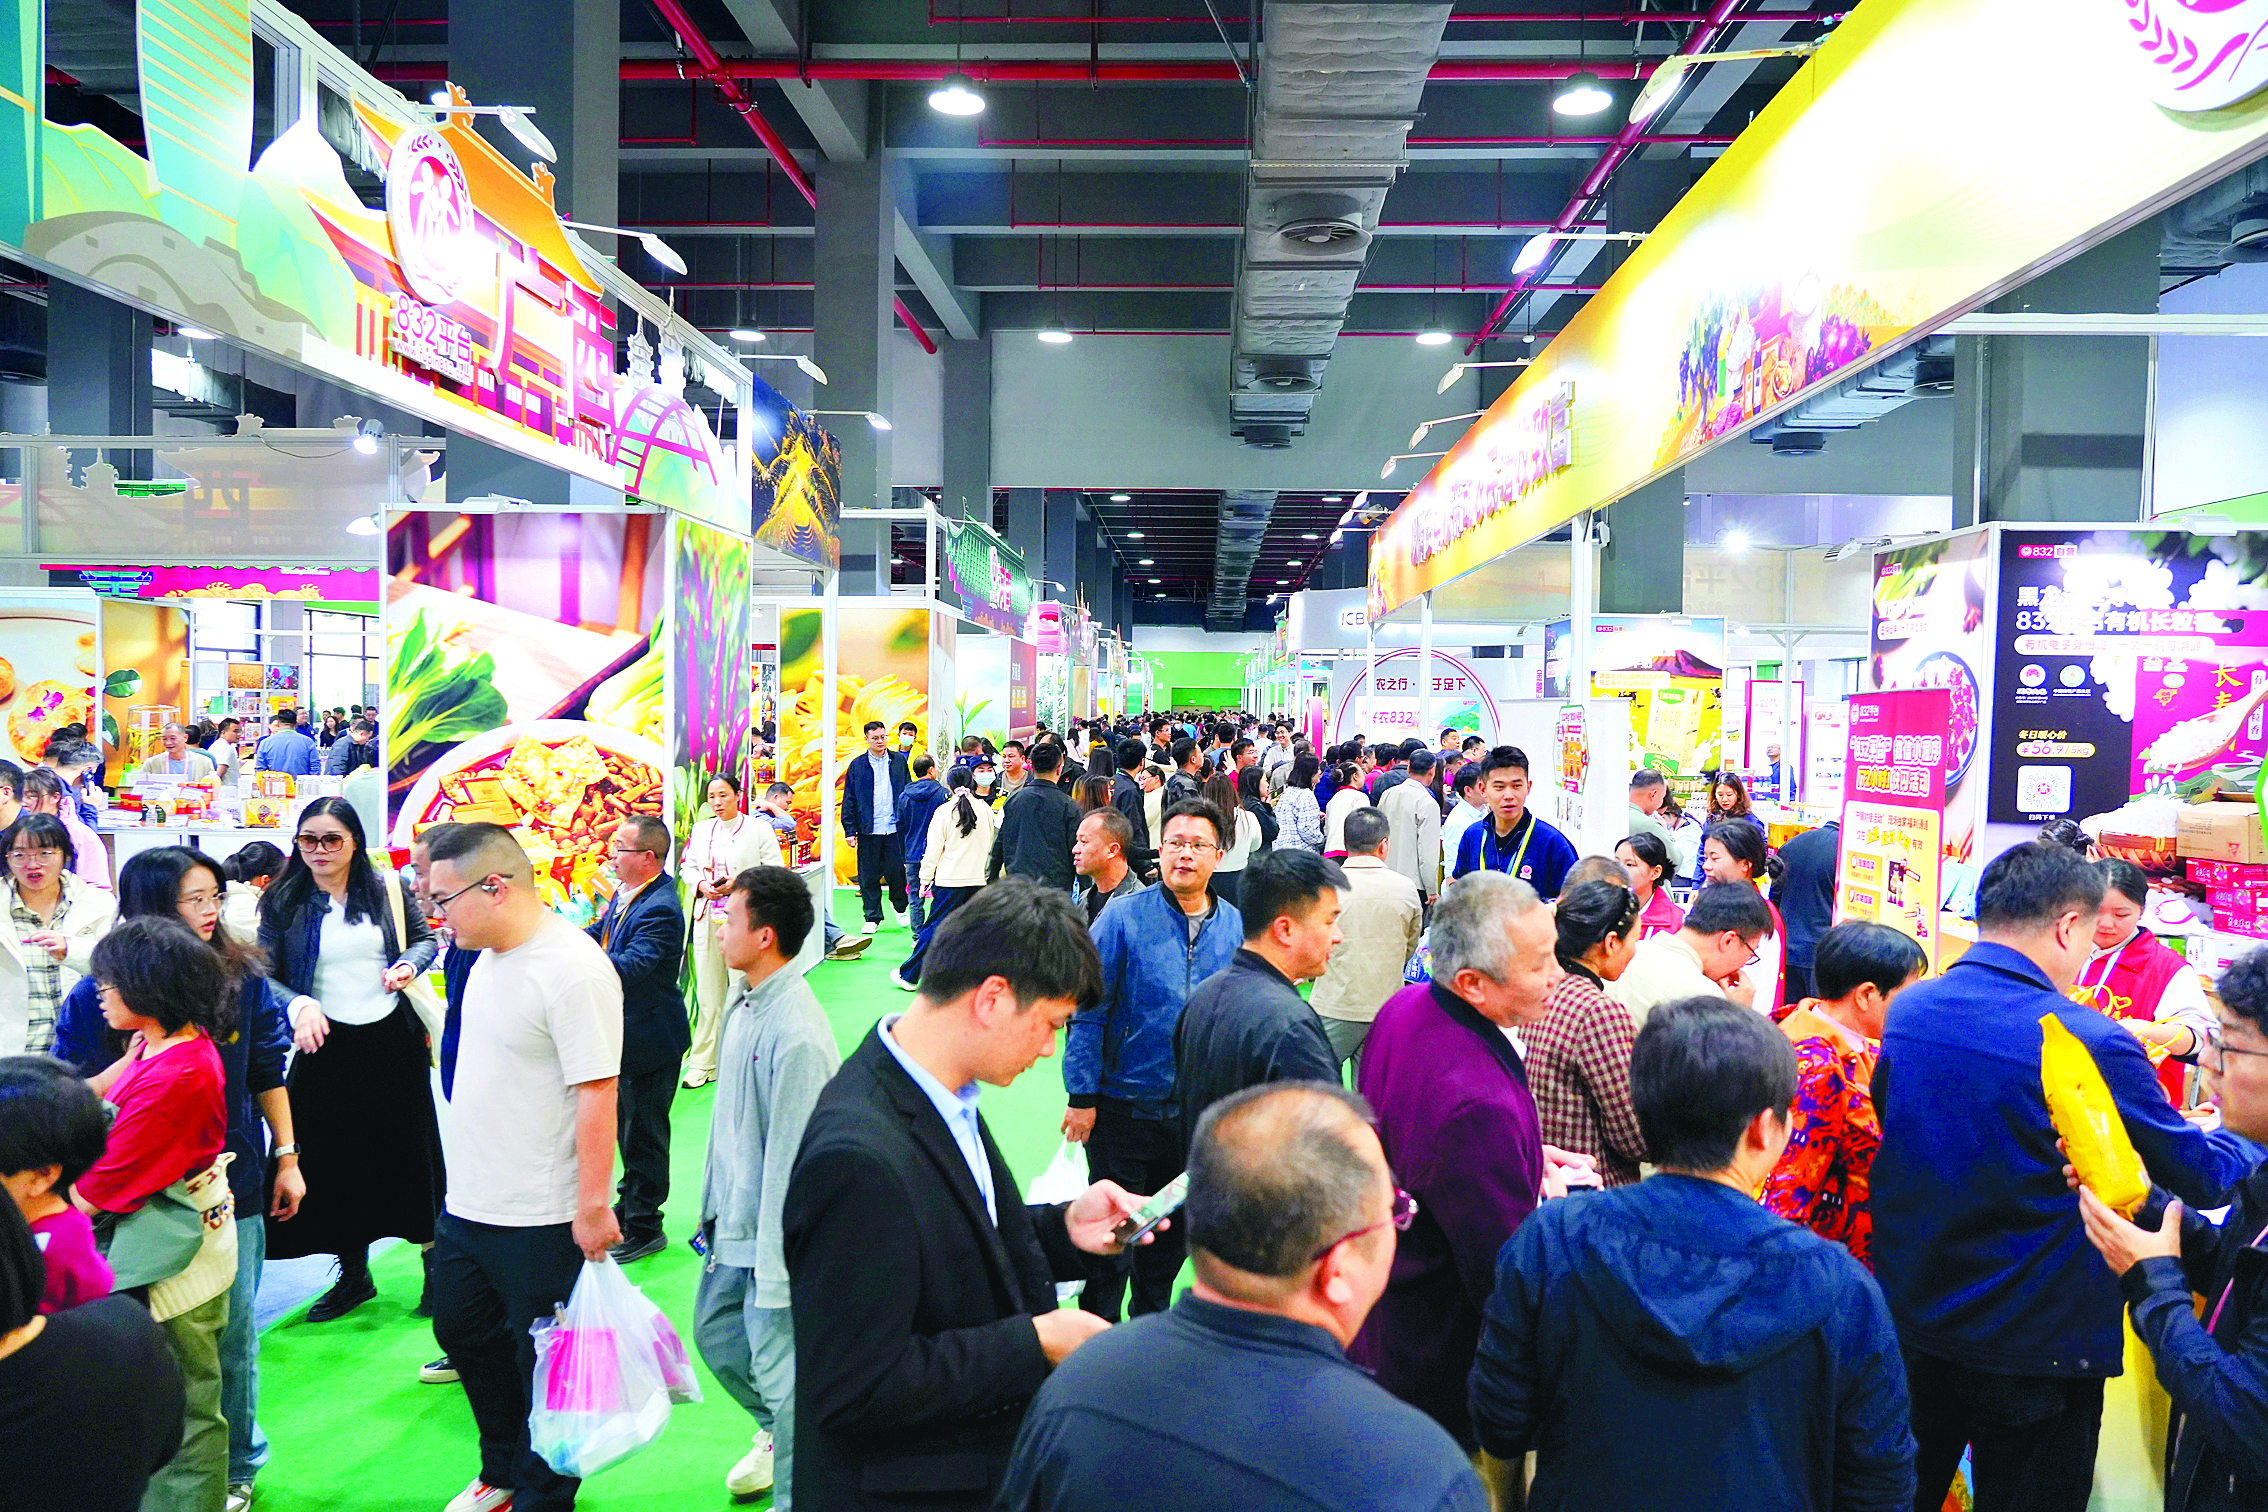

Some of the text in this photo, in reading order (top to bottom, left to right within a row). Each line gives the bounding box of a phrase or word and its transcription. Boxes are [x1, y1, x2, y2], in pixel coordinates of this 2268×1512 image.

[397, 294, 471, 363] 832平台
[2025, 639, 2108, 651] 有机电子身份证
[1860, 705, 1879, 717] 832平台
[1894, 735, 1942, 766] 微信小程序
